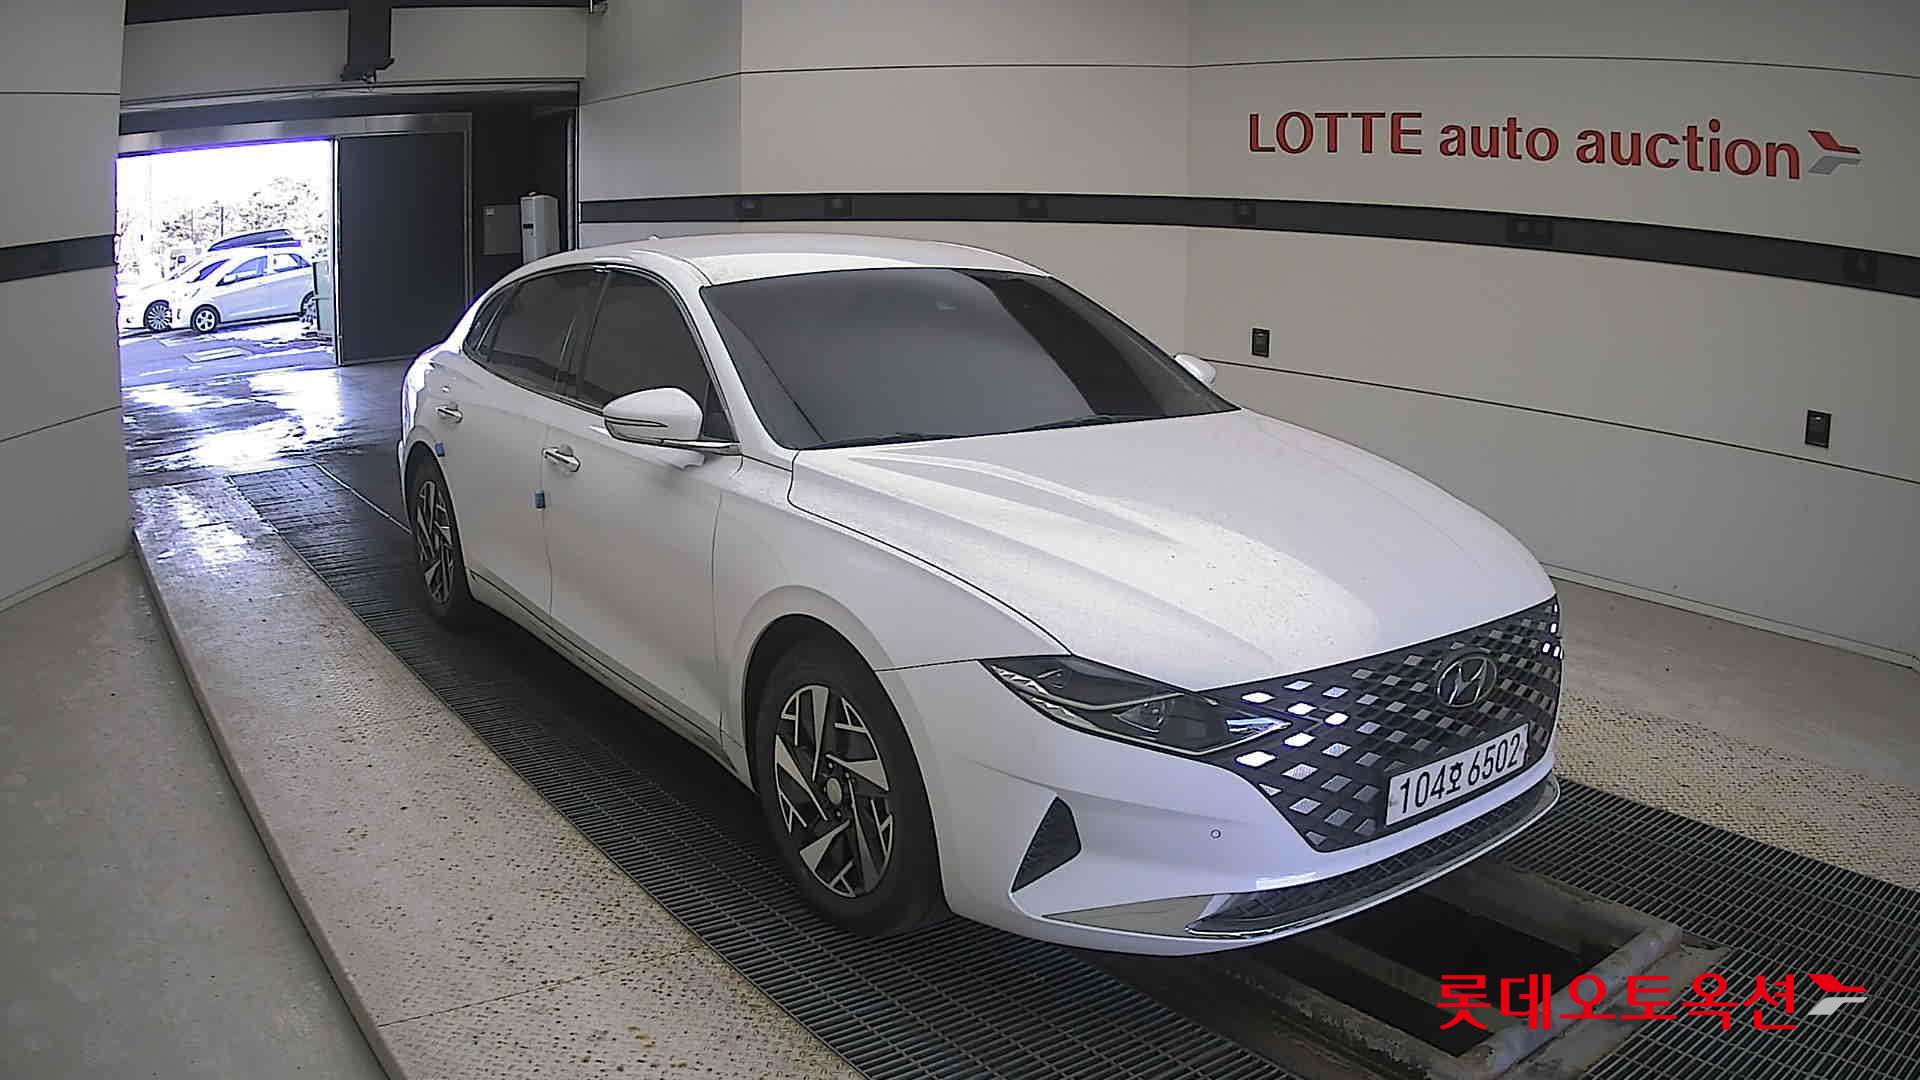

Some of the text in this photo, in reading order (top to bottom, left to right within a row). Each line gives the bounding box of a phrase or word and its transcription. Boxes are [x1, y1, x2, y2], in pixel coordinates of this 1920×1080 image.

[1248, 111, 1801, 181] LOTTE auto auction
[1400, 732, 1522, 814] 104호 6502
